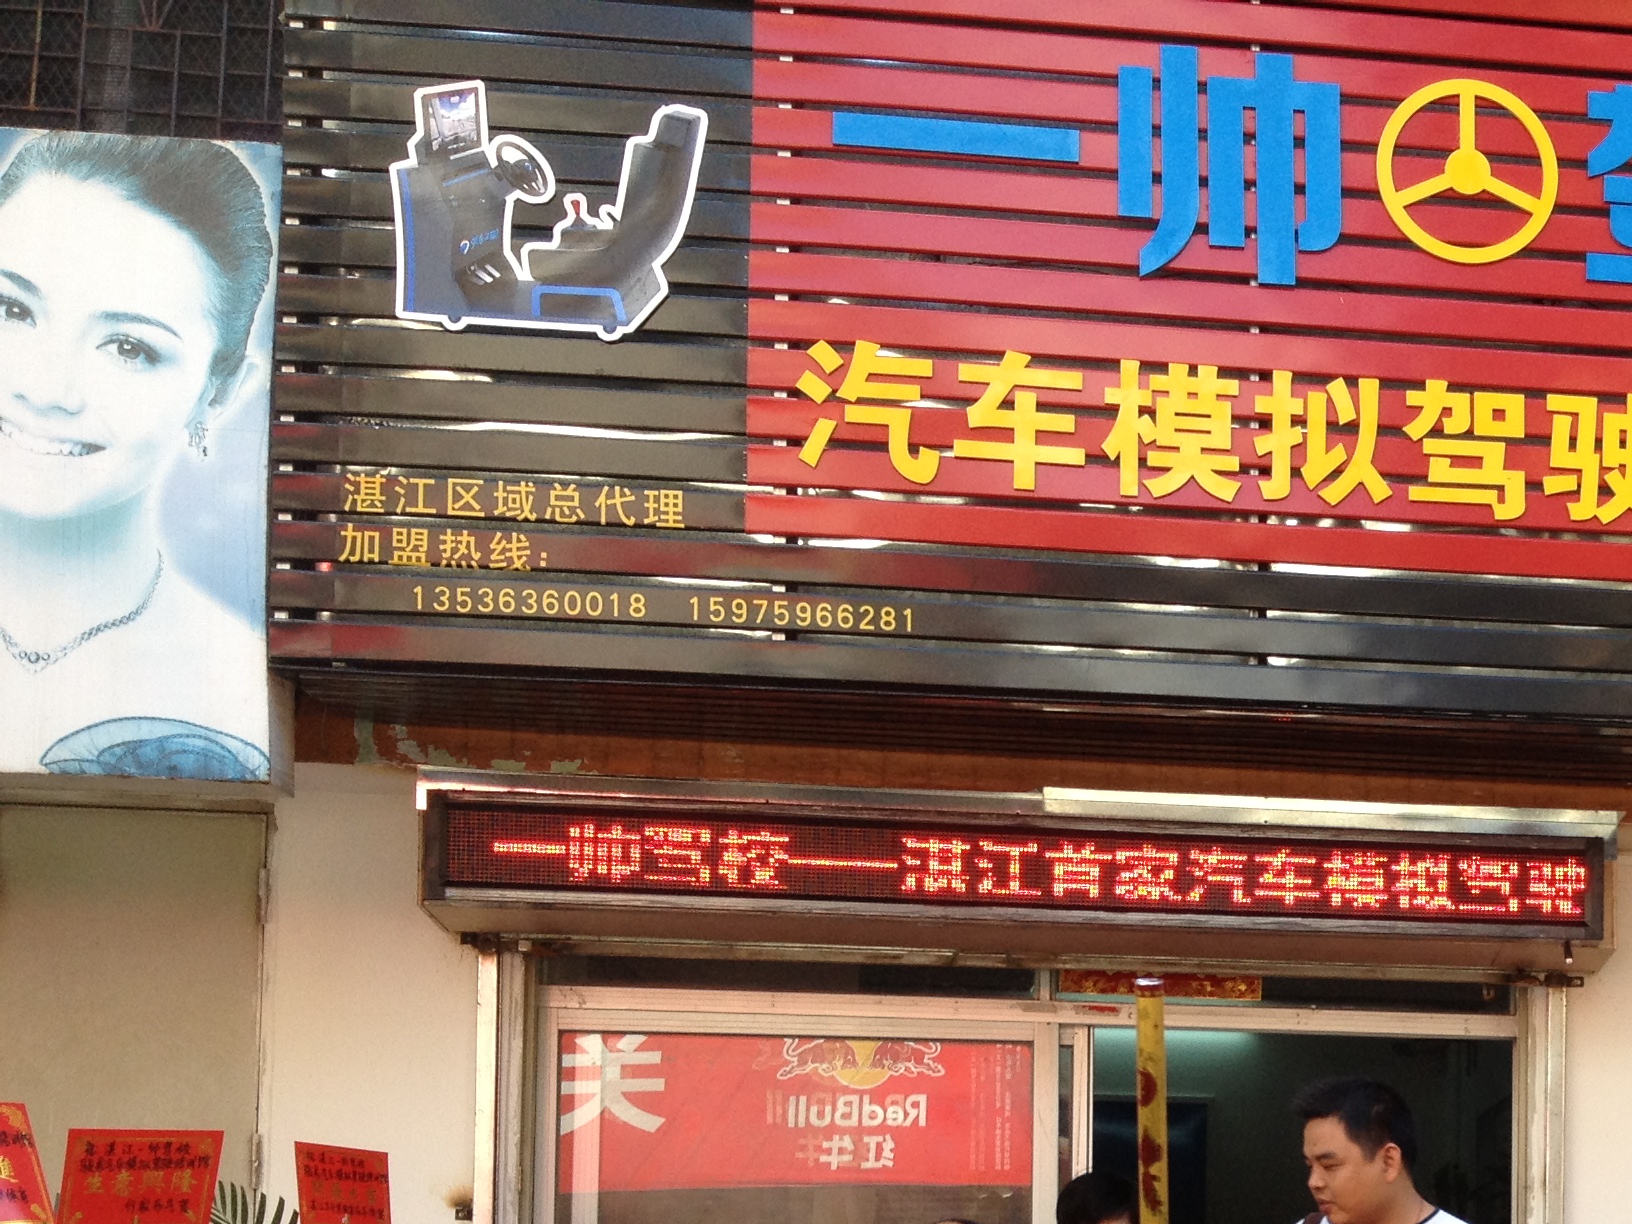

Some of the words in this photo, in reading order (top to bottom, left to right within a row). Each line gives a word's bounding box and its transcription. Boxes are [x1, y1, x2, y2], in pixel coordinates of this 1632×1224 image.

[341, 472, 687, 531] 湛江区域总代理
[411, 584, 648, 620] 13536360018
[688, 595, 916, 634] 15975966281
